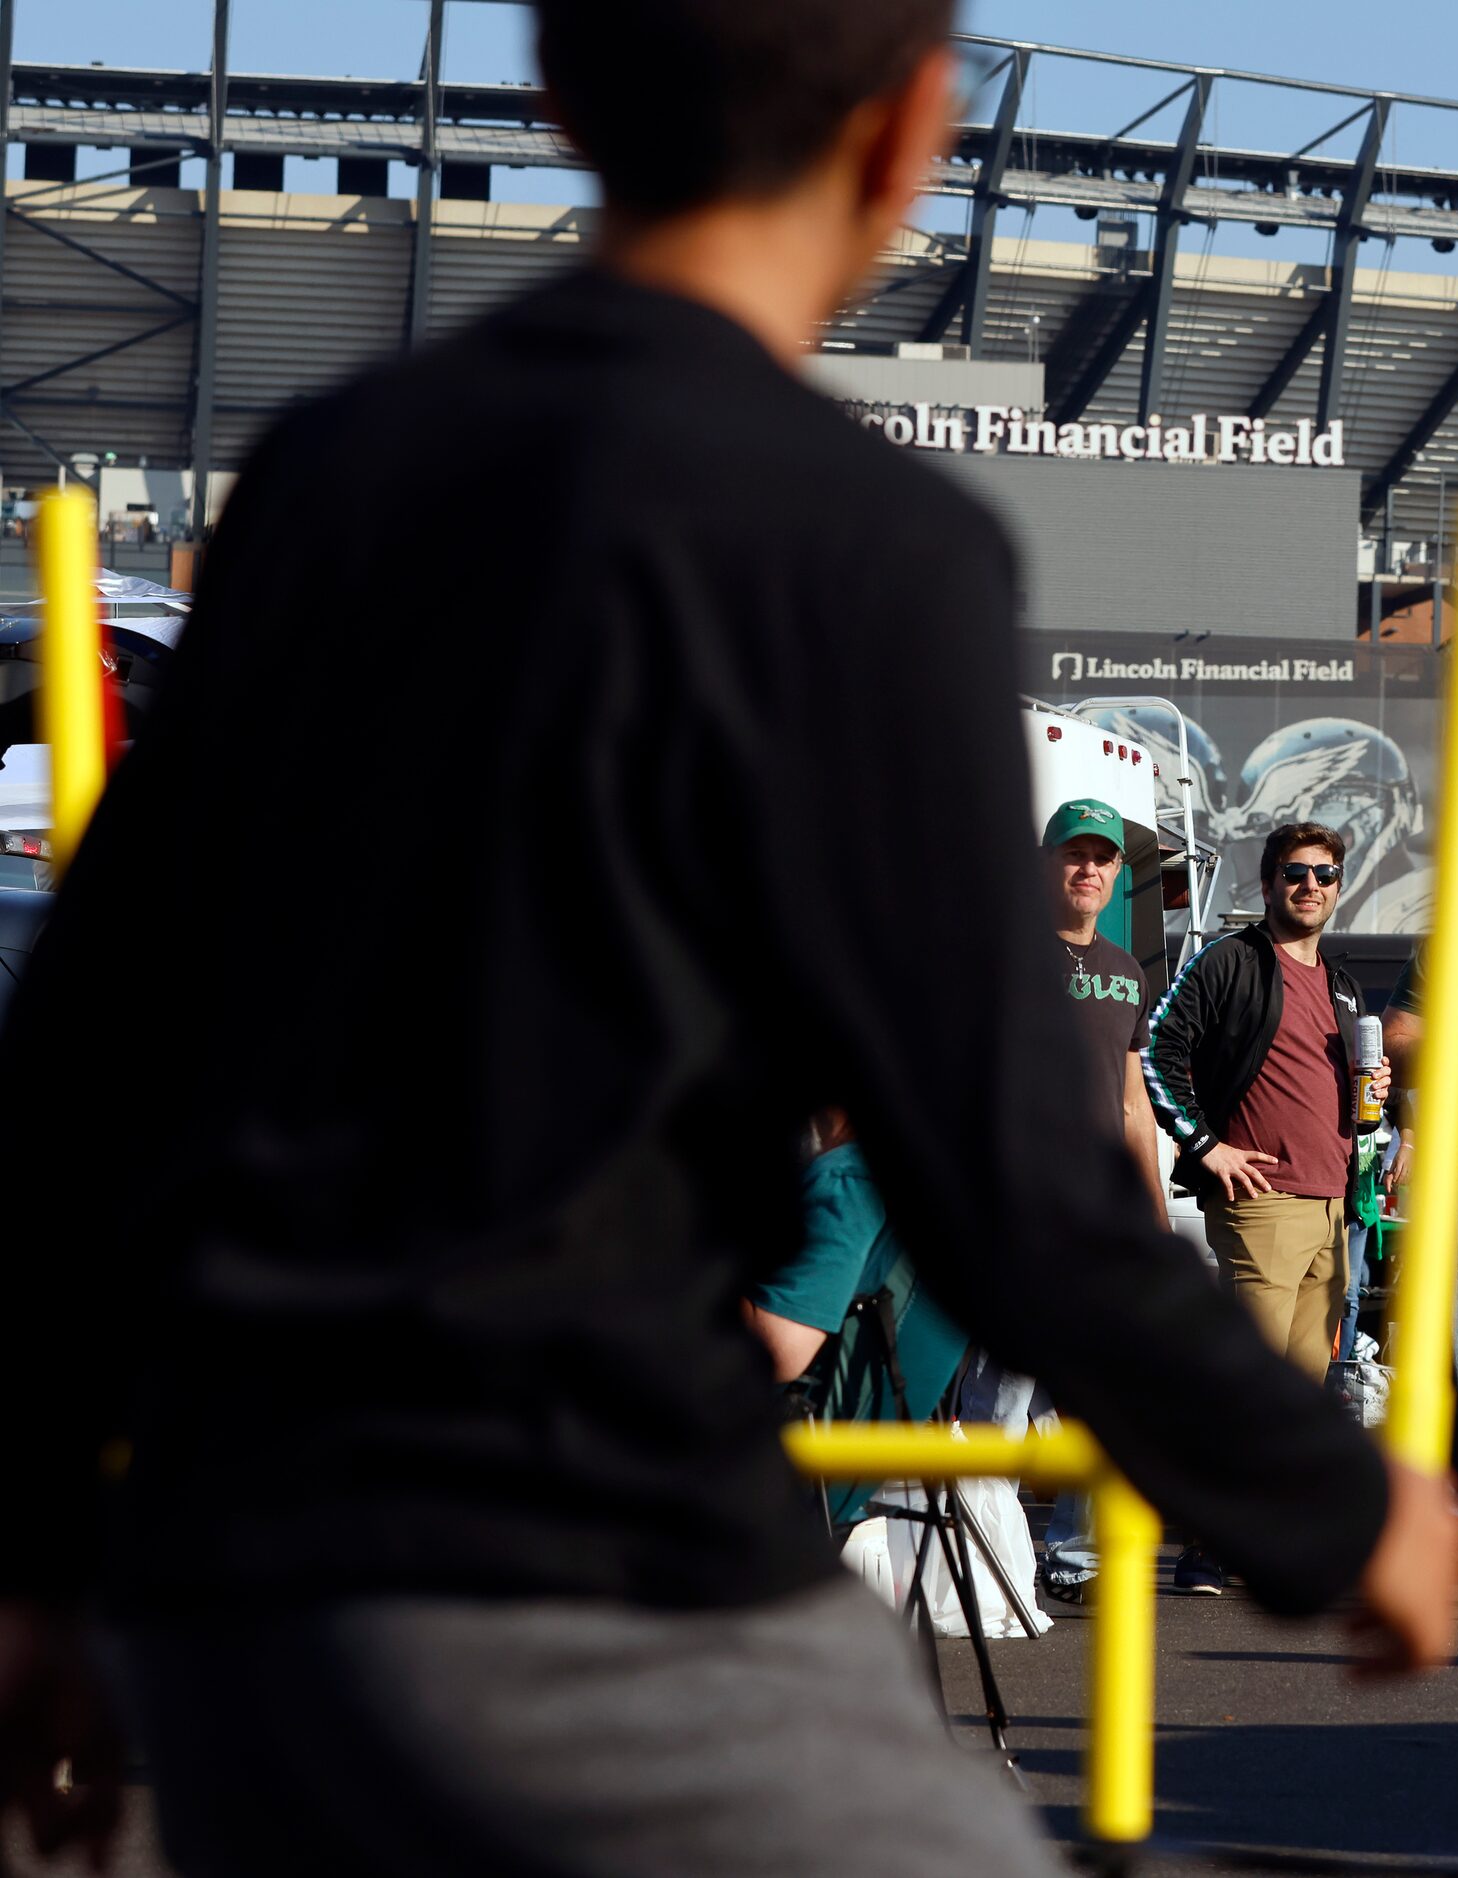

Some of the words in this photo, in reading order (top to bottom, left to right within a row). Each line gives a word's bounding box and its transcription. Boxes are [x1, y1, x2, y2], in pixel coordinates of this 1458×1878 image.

[861, 402, 965, 450] coln
[974, 404, 1208, 460] Financial
[1217, 416, 1345, 466] Field
[1087, 657, 1178, 680] Lincoln
[1181, 658, 1290, 681] Financial
[1293, 659, 1354, 682] Field
[1069, 973, 1140, 1006] GLES
